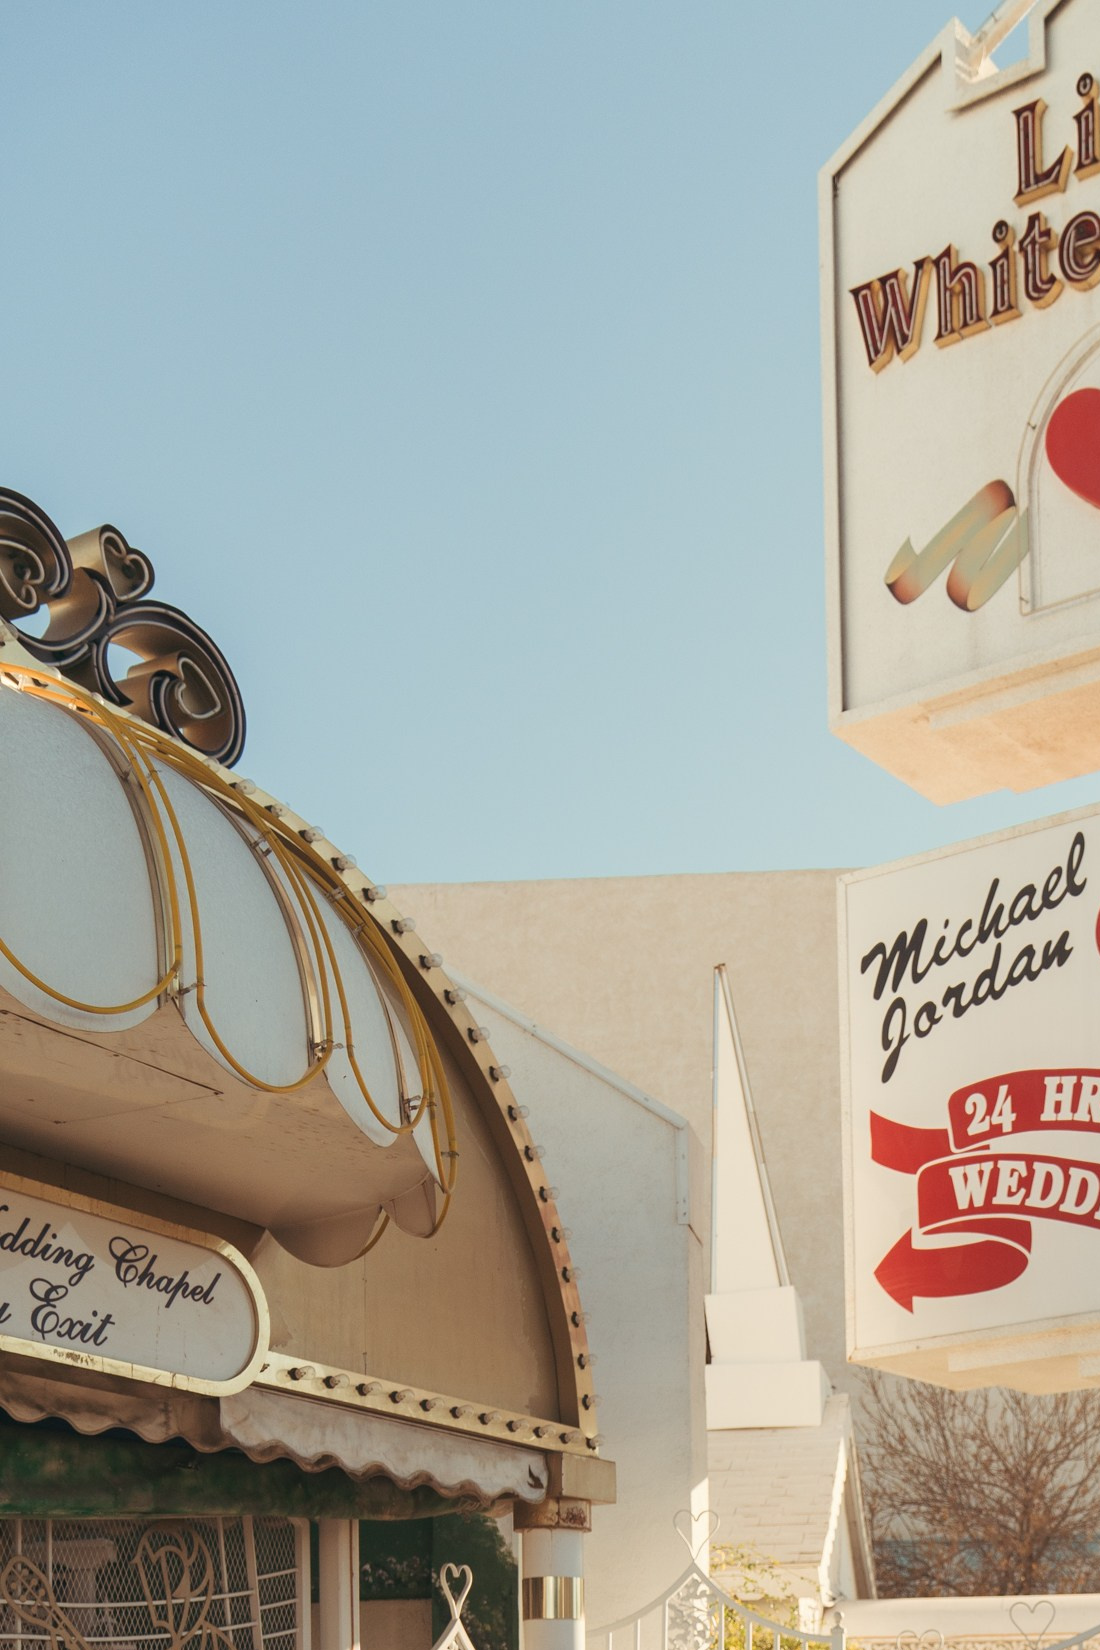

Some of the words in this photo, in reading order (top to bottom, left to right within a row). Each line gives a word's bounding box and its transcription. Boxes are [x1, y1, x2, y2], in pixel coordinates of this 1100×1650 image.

[860, 831, 1087, 1001] Michael
[881, 930, 1074, 1083] Jordan
[963, 1084, 1016, 1136] 24
[0, 1205, 95, 1287] dding
[109, 1236, 222, 1309] Chapel
[29, 1278, 116, 1346] Exit
